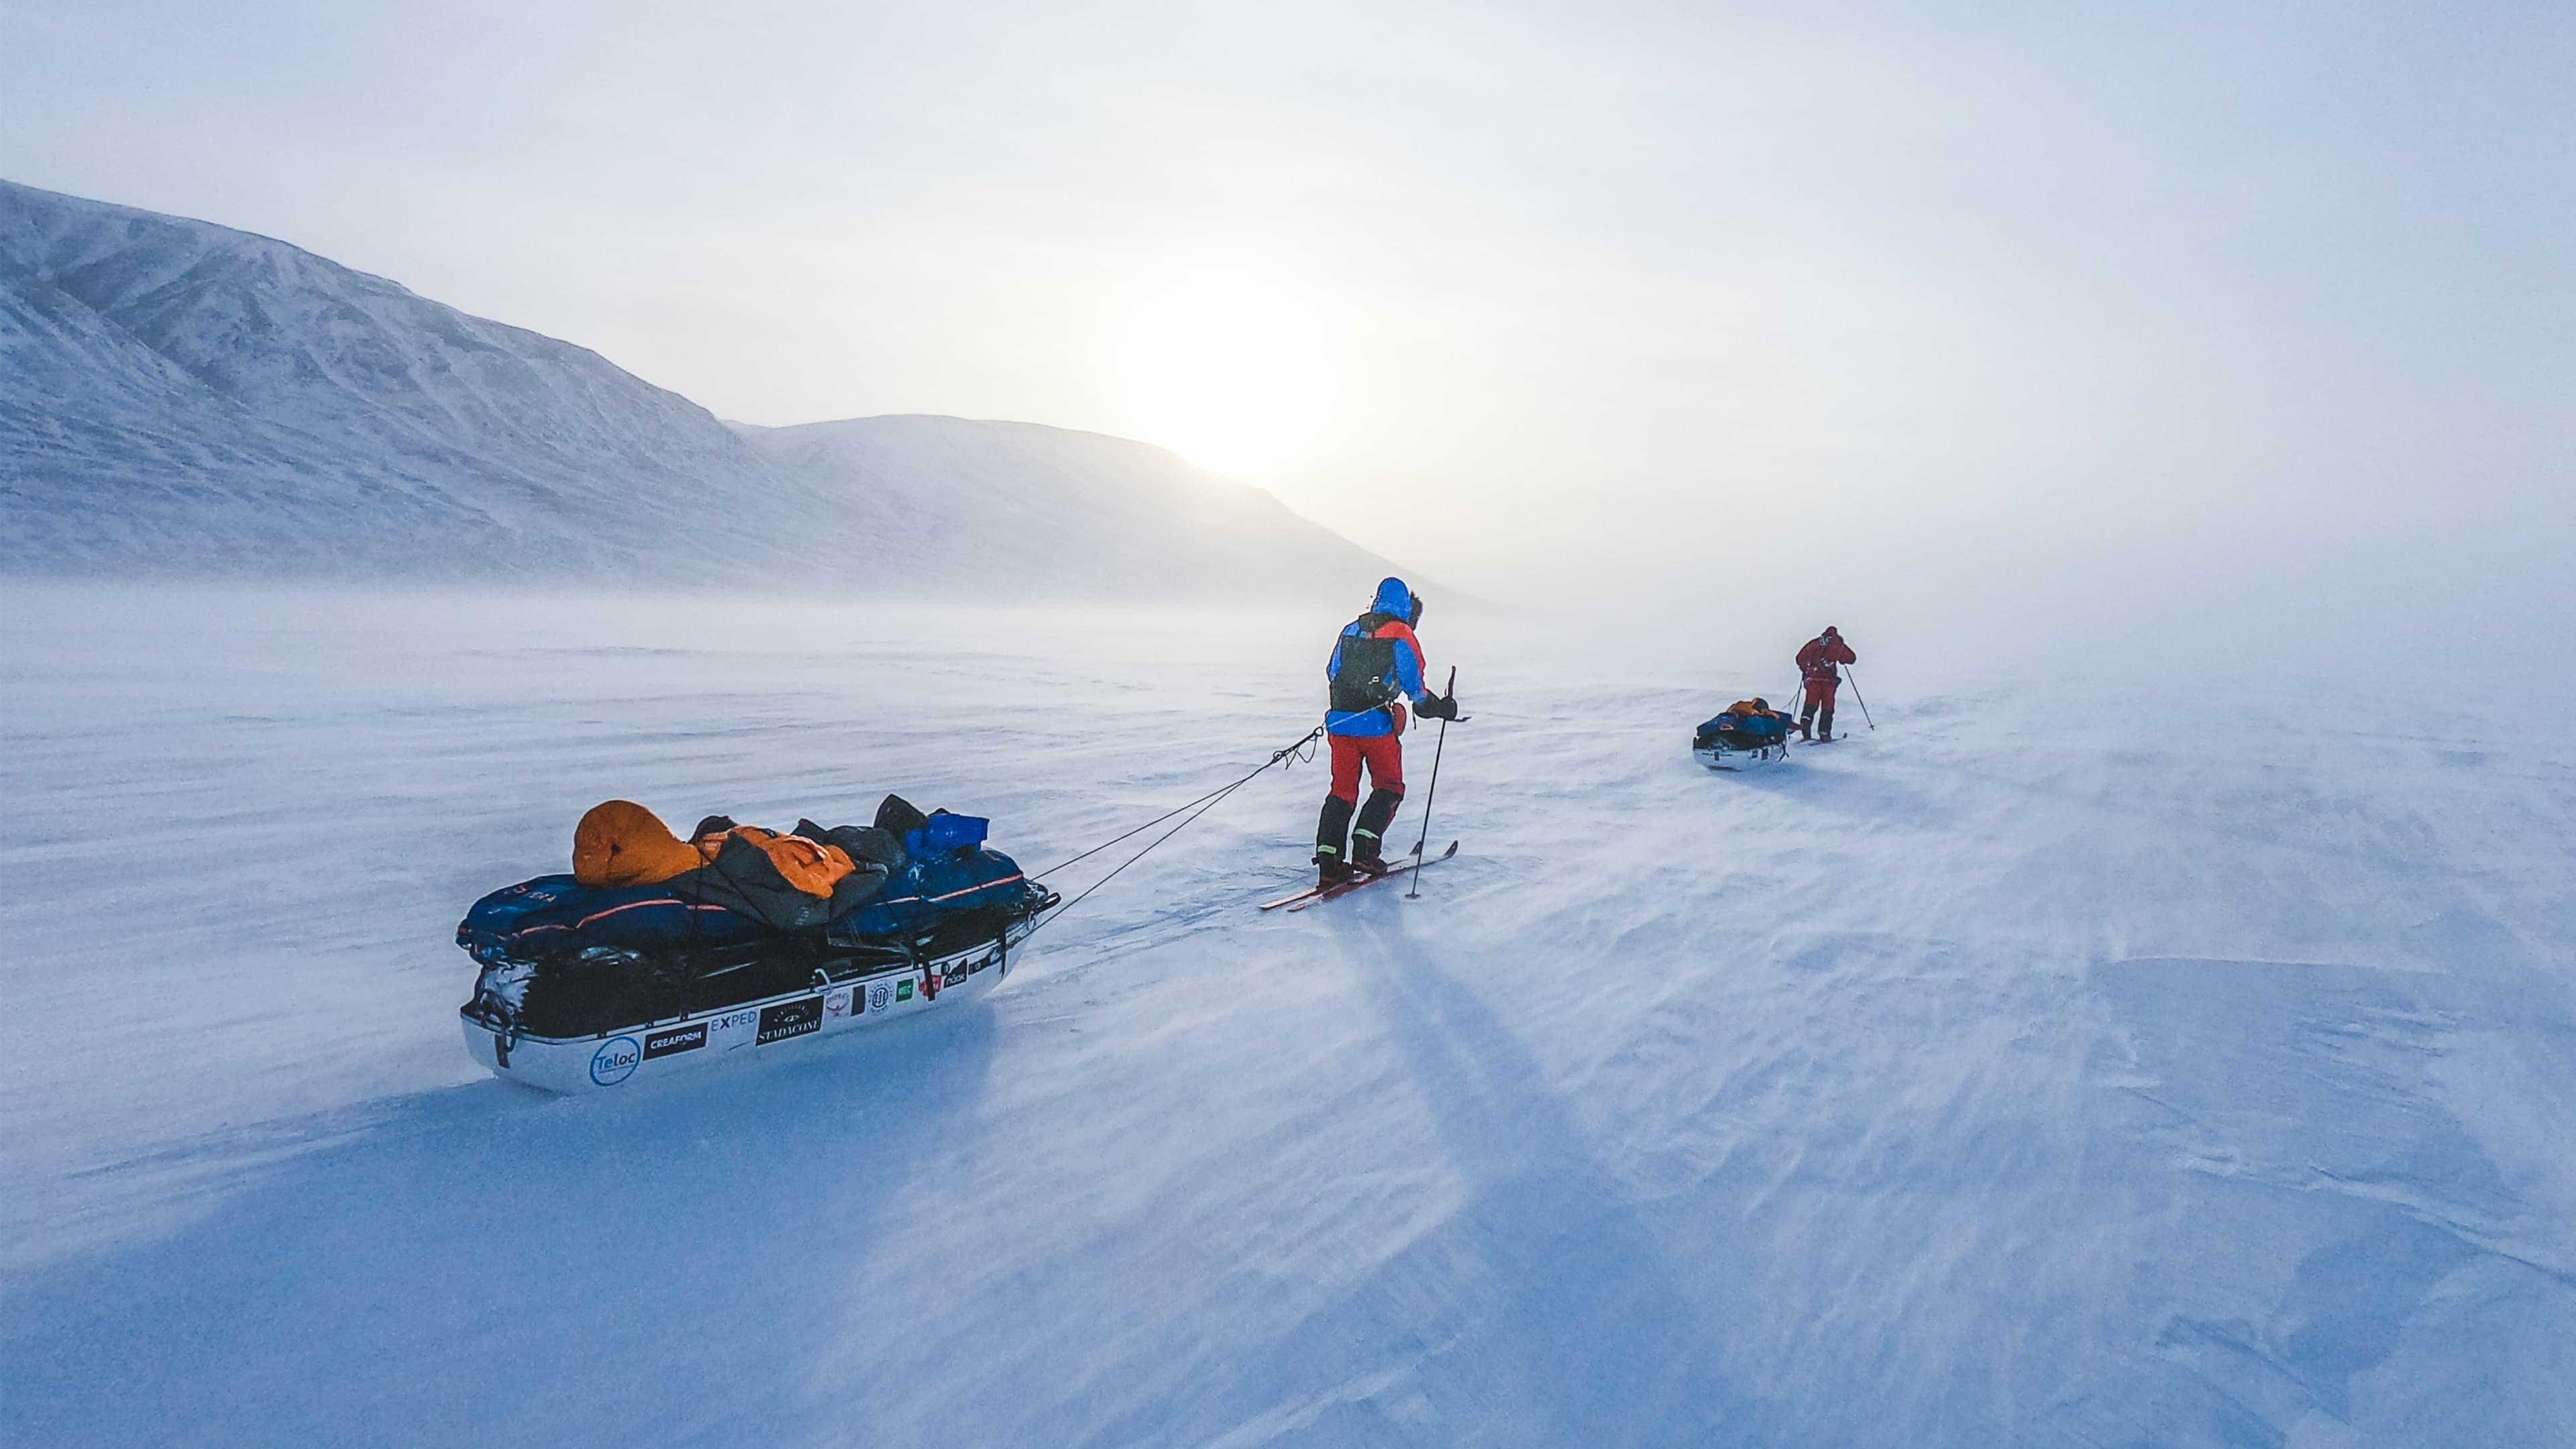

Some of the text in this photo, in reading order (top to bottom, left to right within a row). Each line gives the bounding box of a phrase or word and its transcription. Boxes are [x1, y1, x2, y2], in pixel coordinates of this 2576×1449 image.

[711, 1011, 757, 1032] EXPED
[649, 1031, 702, 1049] CREAFORM
[596, 1052, 636, 1069] Teloc
